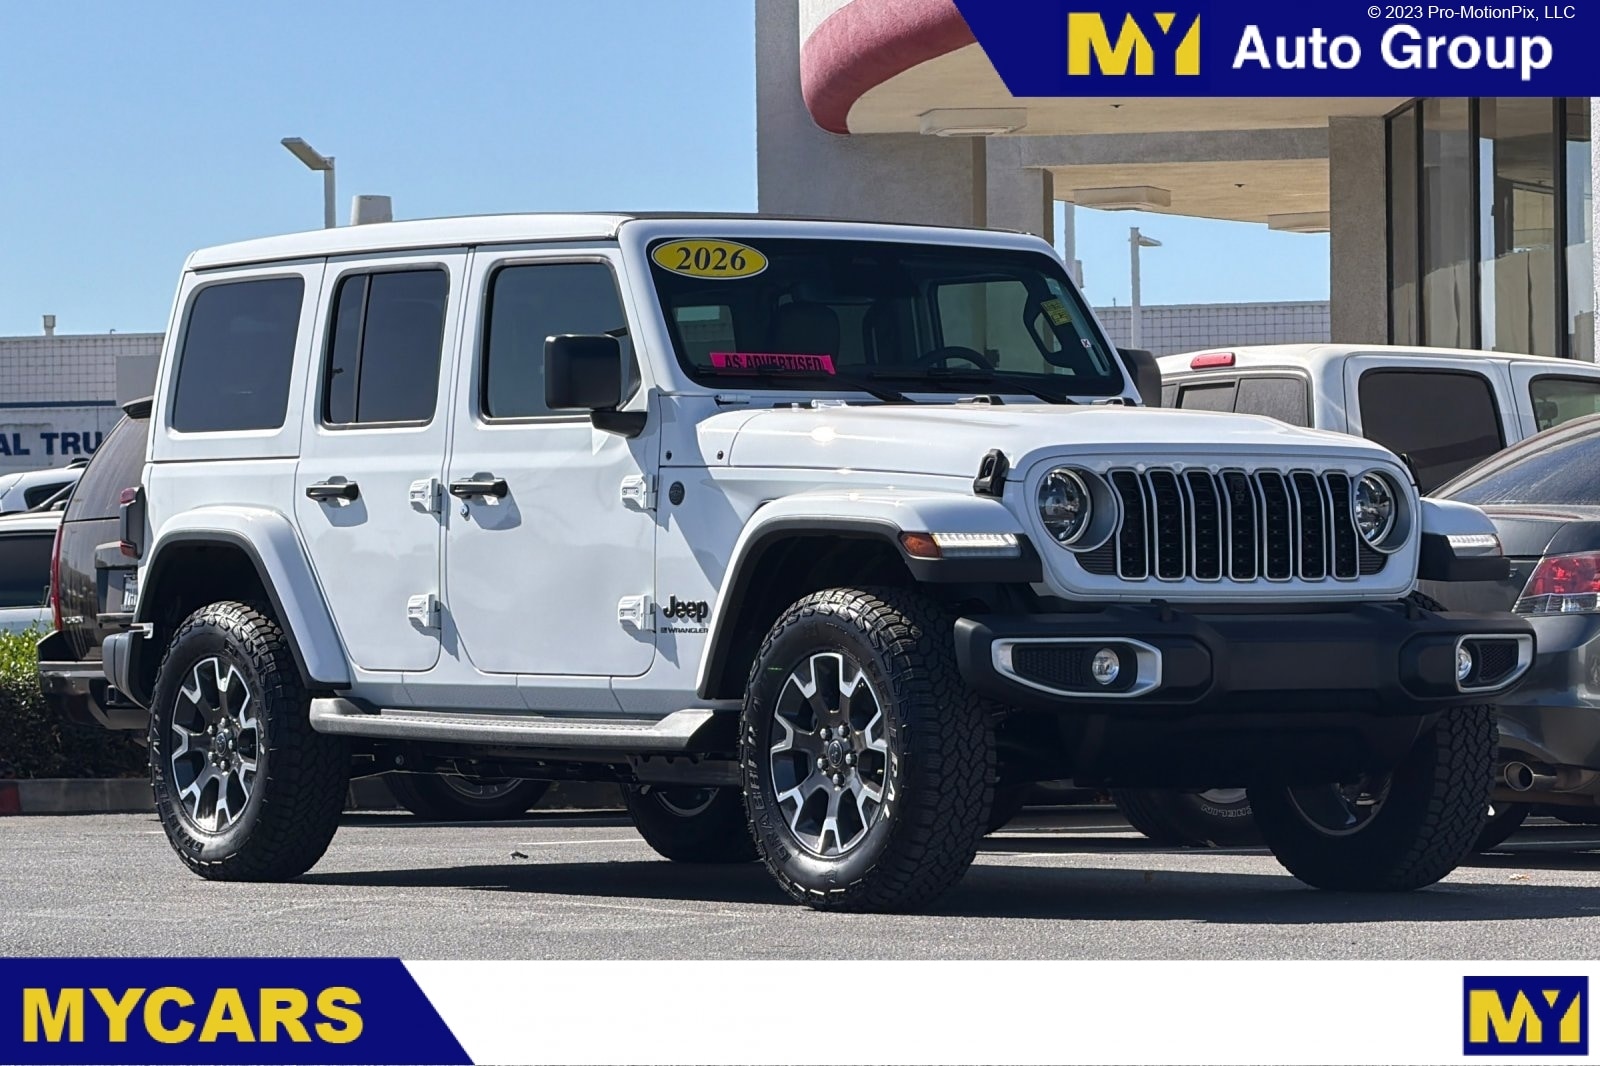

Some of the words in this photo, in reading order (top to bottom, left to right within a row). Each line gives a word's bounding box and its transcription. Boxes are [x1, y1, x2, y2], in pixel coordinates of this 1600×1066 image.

[675, 247, 747, 271] 2026
[725, 354, 742, 368] AS
[662, 594, 709, 623] Jeep
